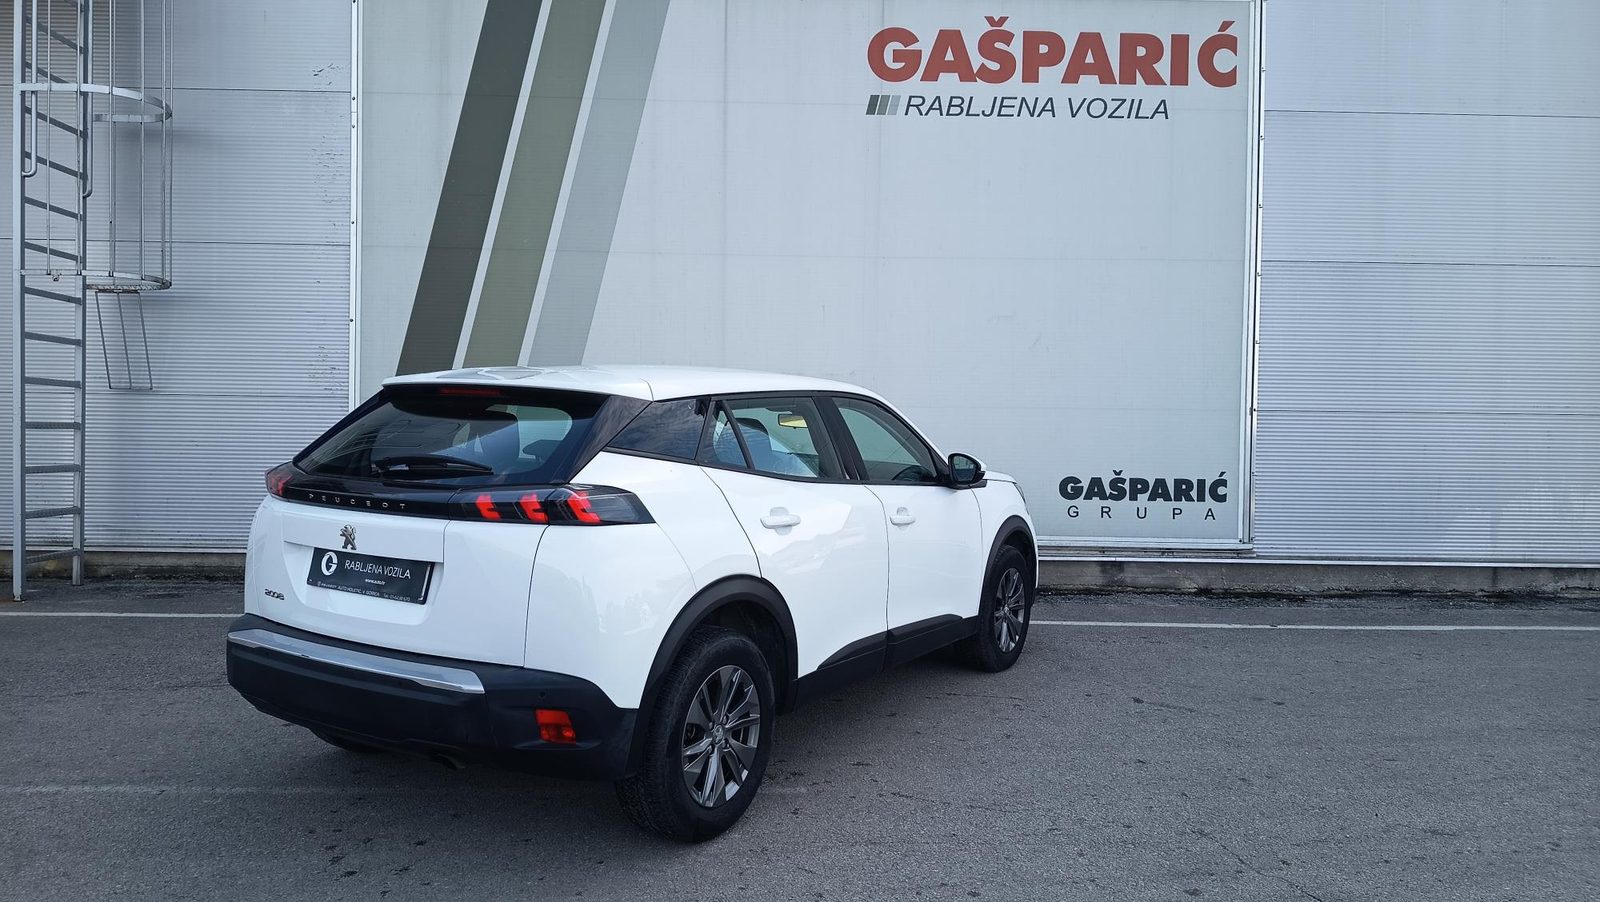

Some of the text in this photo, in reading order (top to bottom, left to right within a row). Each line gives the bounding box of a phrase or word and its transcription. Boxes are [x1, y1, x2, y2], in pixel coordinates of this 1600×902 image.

[867, 16, 1238, 88] GAŠPARIĆ
[904, 95, 1169, 120] RABLJENA VOZILA
[1058, 469, 1228, 503] GAŠPARIĆ
[308, 493, 406, 510] PEUGEOT
[1067, 505, 1216, 521] GRUPA
[344, 559, 411, 580] RABLJENA VOZILA
[264, 588, 285, 601] 2008
